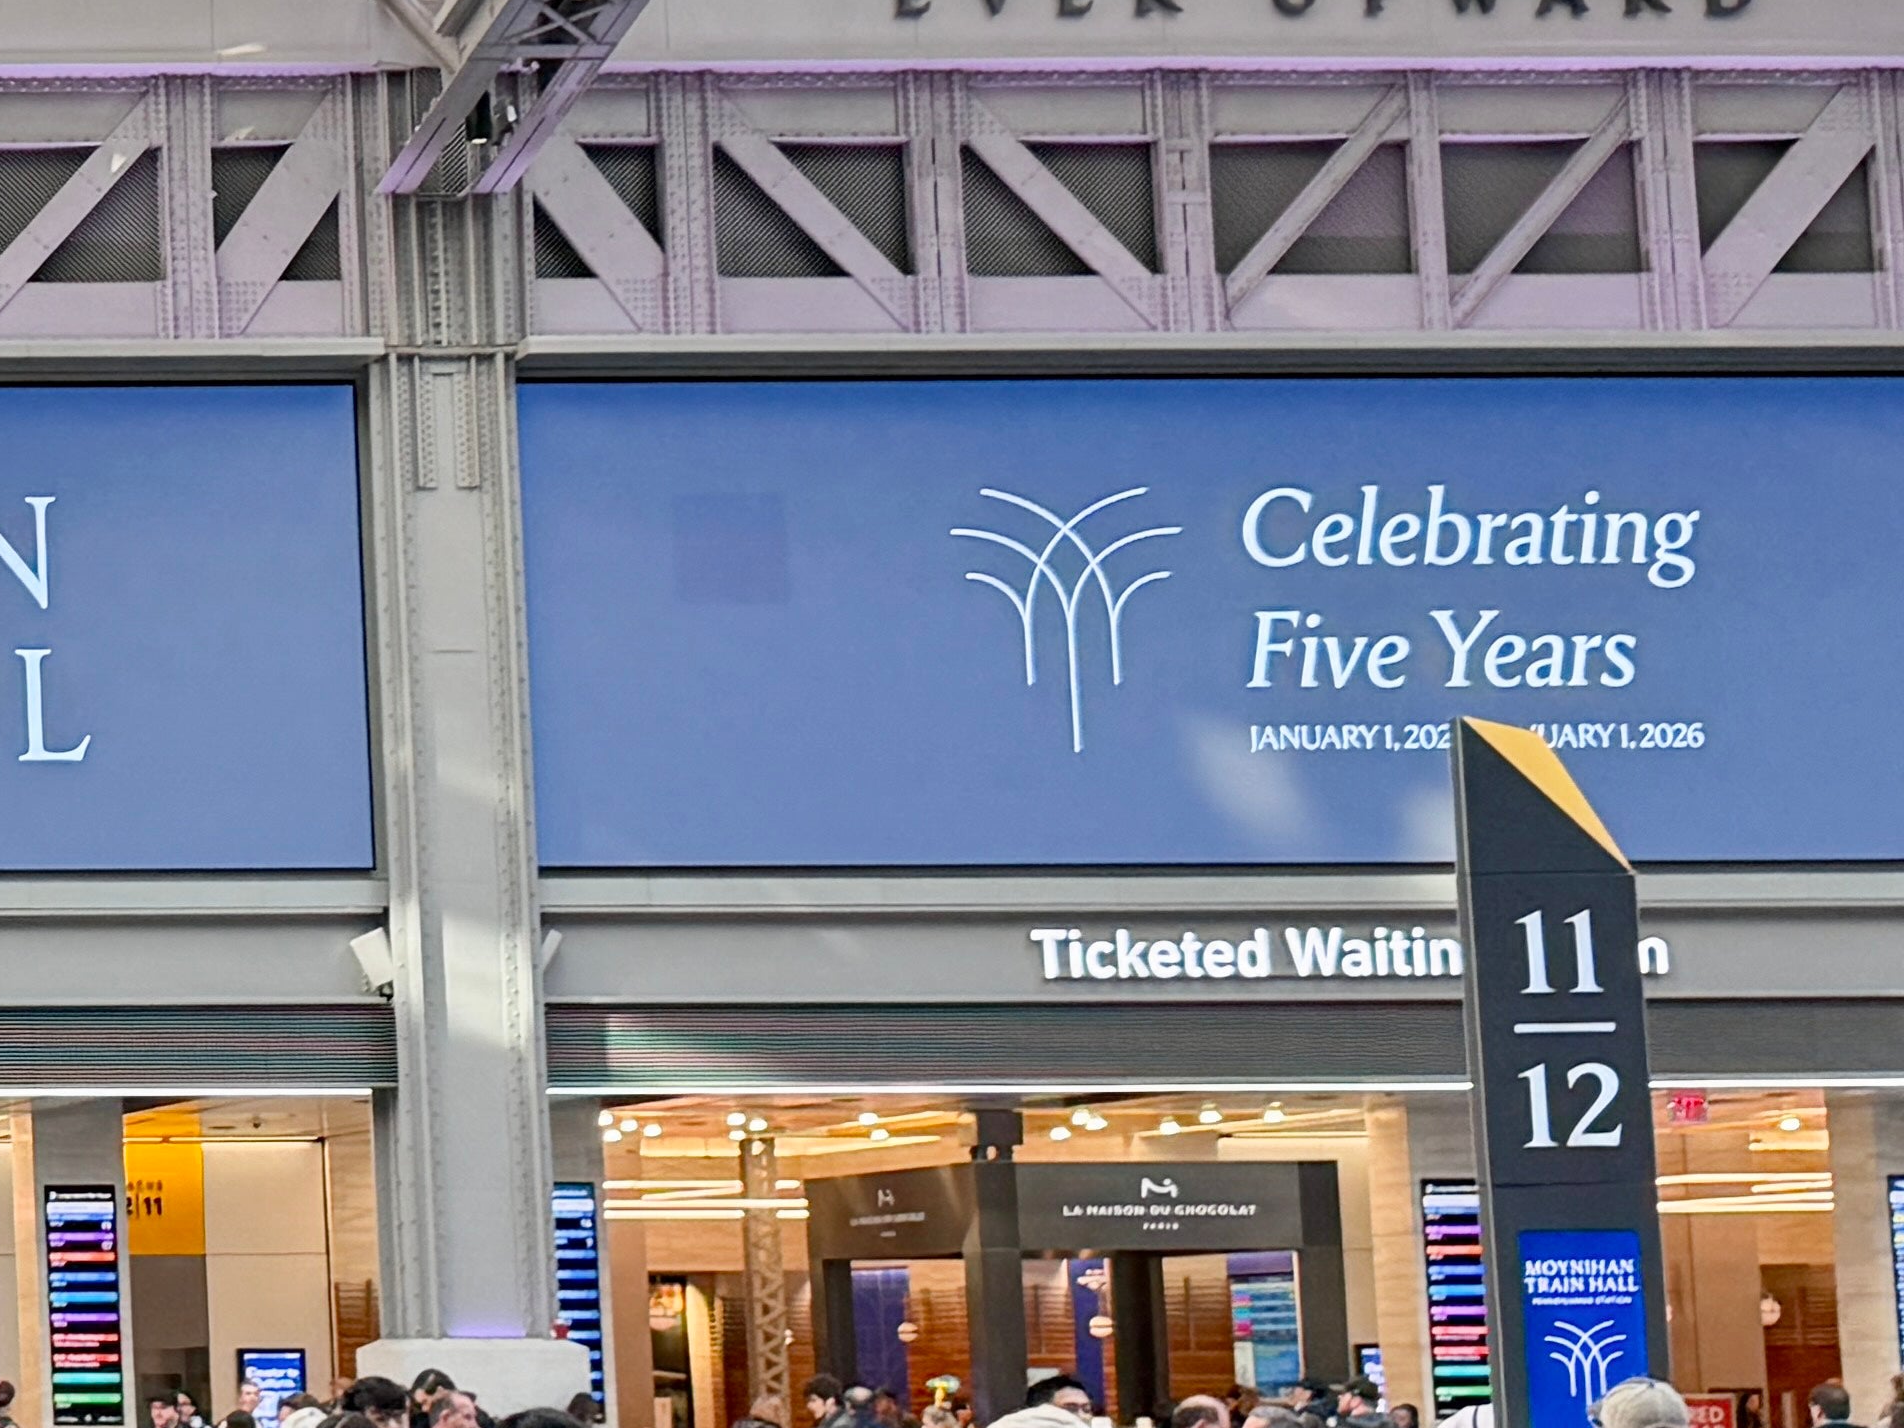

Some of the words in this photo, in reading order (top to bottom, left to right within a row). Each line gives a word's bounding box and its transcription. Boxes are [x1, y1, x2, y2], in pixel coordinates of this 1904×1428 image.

[1242, 485, 1701, 589] Celebrating
[1246, 610, 1411, 689] Five
[1429, 609, 1638, 689] Years
[1250, 724, 1380, 753] JANUARY
[1403, 723, 1451, 750] 202
[1532, 722, 1614, 749] UARY
[1639, 722, 1705, 749] 2026
[1030, 927, 1271, 980] Ticketed
[1285, 925, 1464, 979] Waitin
[1514, 909, 1605, 995] 11
[1518, 1061, 1622, 1150] 12
[1523, 1276, 1585, 1294] TRAIN
[1588, 1275, 1640, 1292] HALL
[1524, 1258, 1635, 1276] MOYNIHAN
